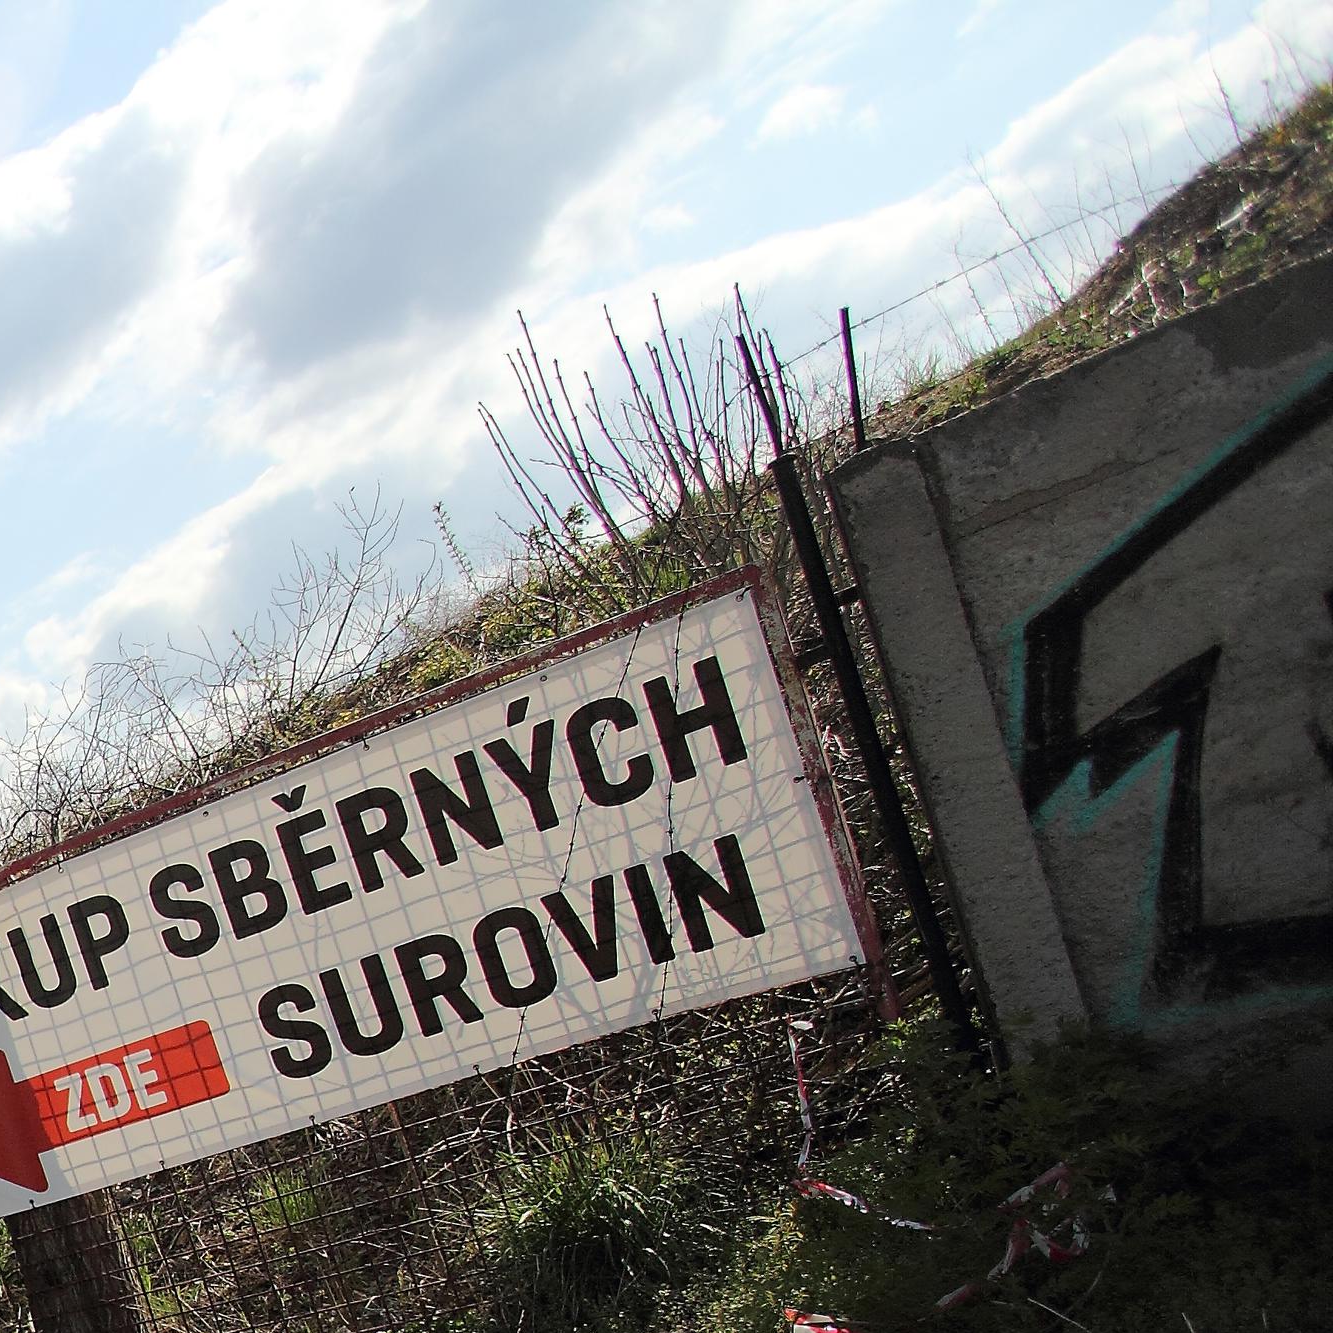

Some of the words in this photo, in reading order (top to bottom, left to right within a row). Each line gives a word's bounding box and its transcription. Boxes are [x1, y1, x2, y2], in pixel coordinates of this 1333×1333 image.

[150, 656, 749, 958] SBĚRNÝCH
[258, 834, 766, 1079] SUROVIN
[54, 1049, 168, 1134] ZDE
